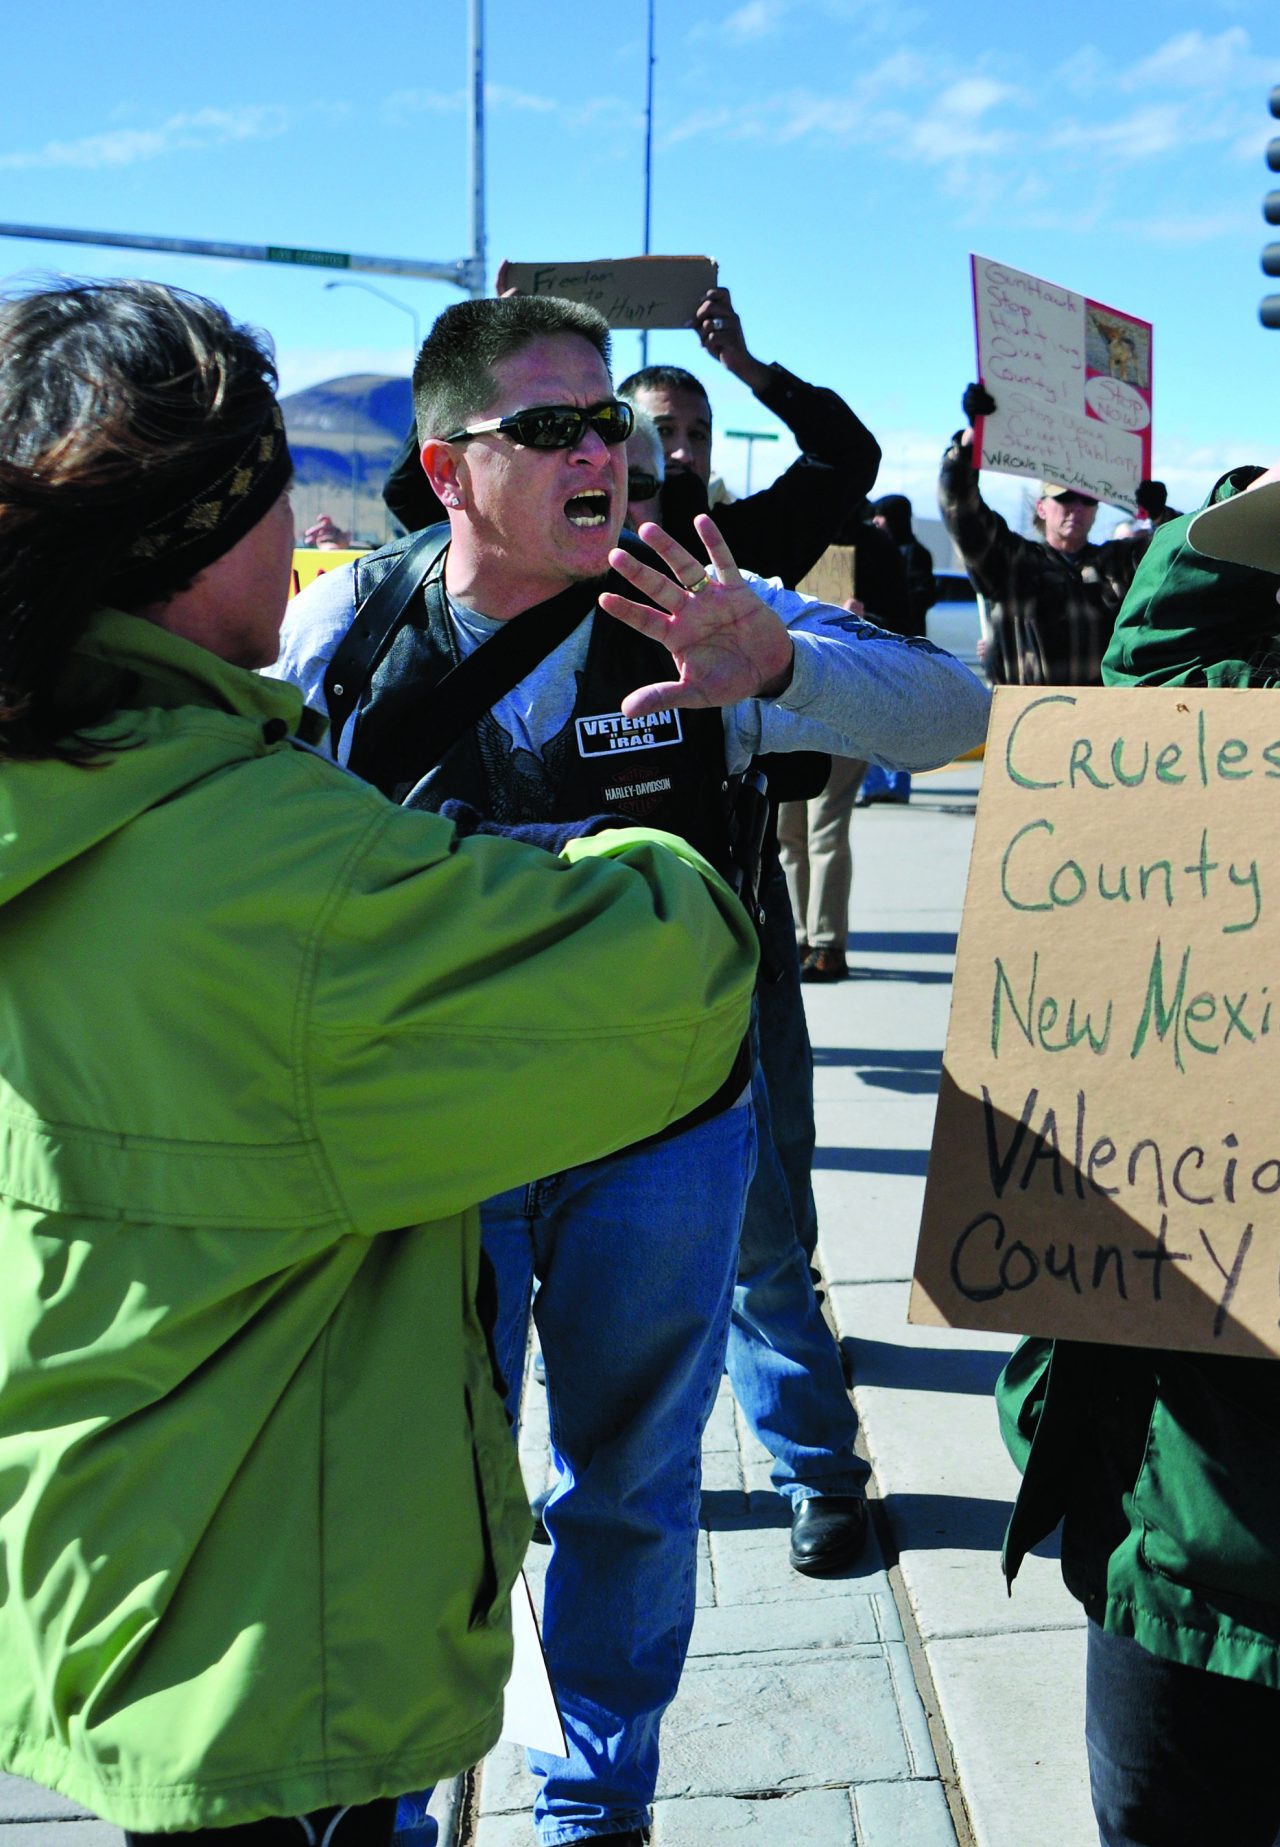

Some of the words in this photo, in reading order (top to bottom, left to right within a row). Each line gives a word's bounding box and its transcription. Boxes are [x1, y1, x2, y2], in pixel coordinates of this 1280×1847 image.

[987, 285, 1031, 328] Stop
[1097, 380, 1143, 415] Stop
[583, 709, 672, 736] VETERAN
[609, 733, 656, 749] IRAQ
[604, 777, 672, 801] HARLEY-DAVIDSON
[1001, 819, 1262, 934] County
[991, 951, 1113, 1059] New
